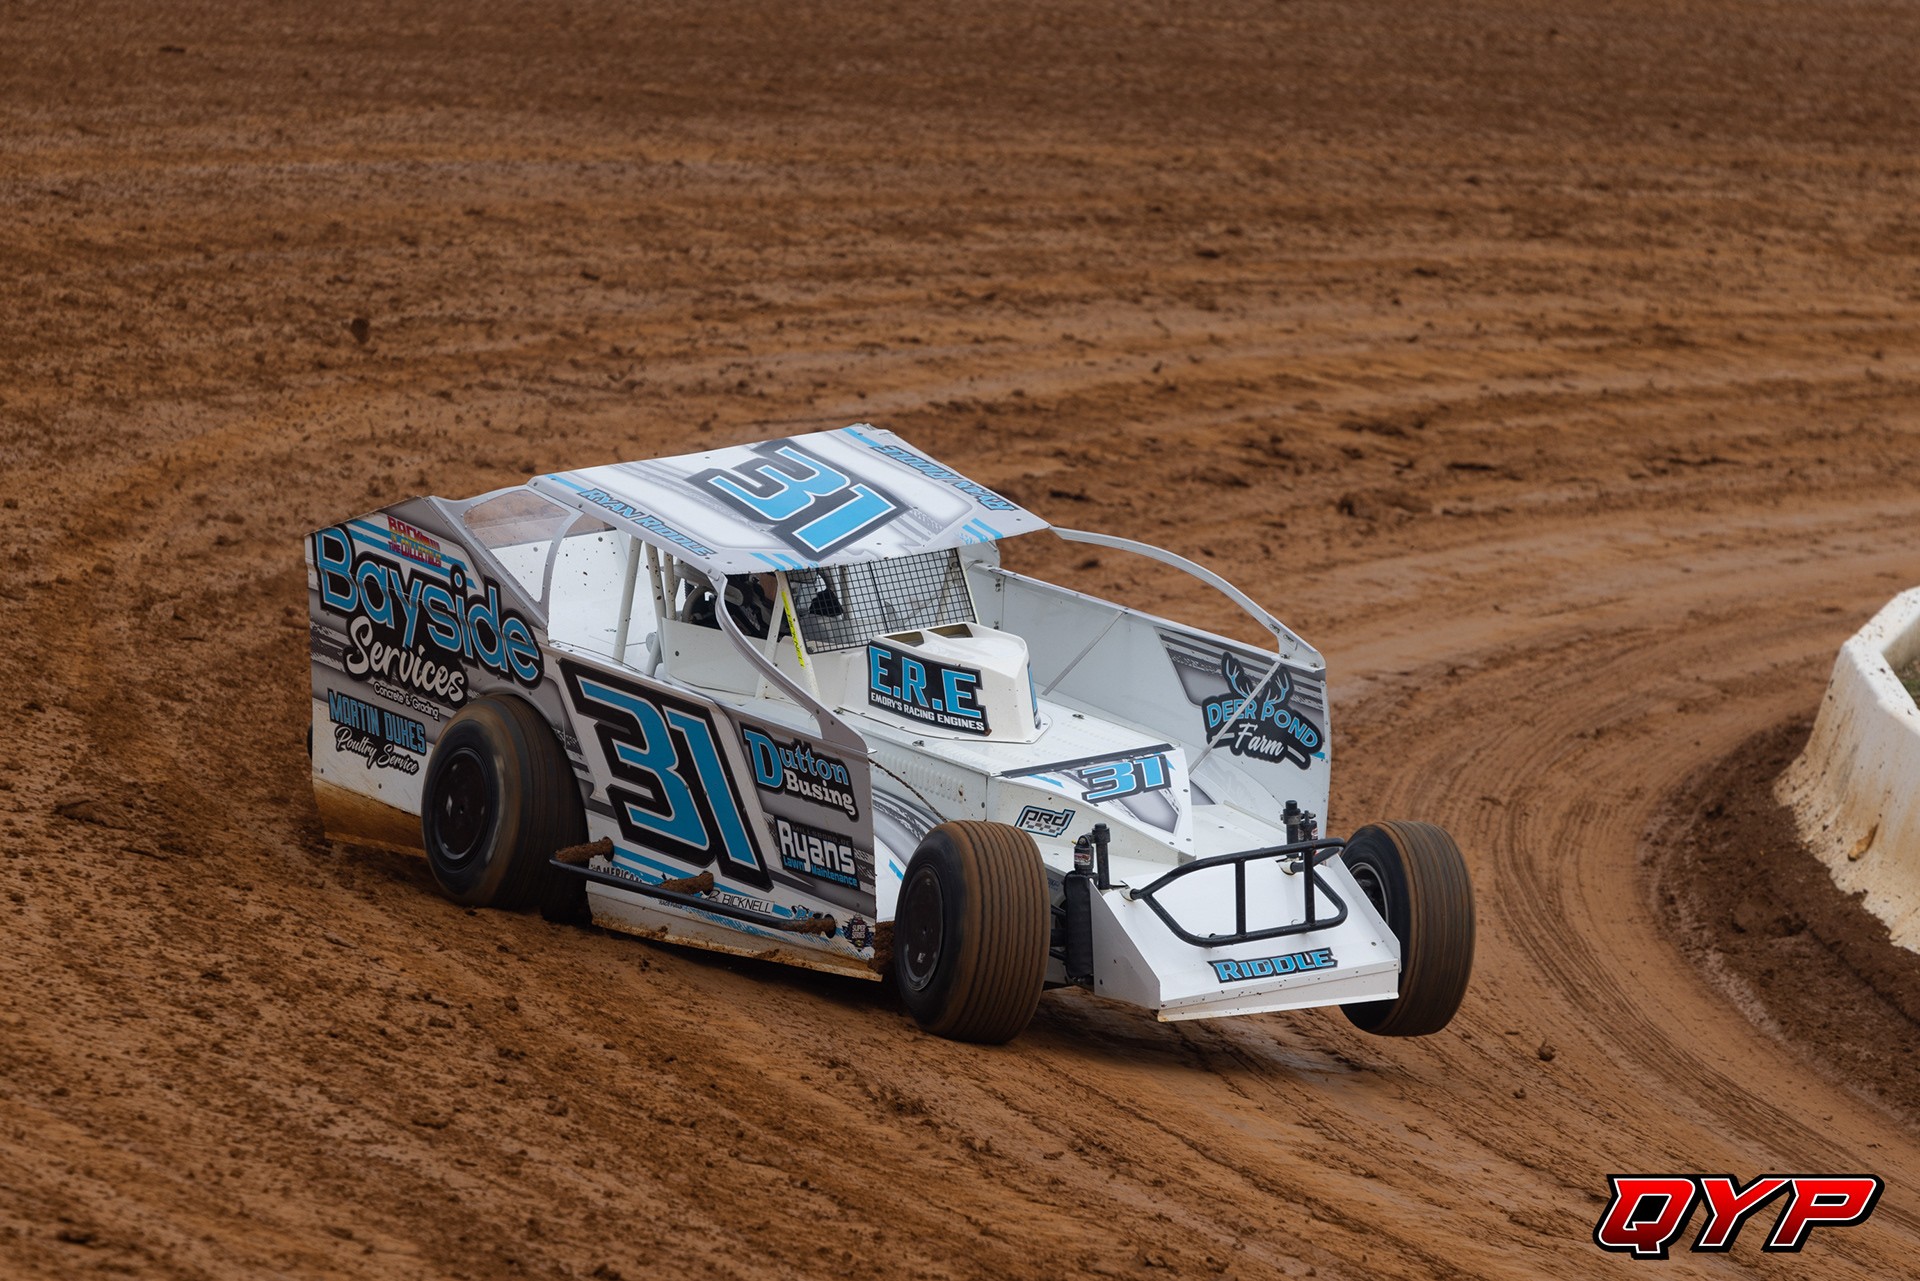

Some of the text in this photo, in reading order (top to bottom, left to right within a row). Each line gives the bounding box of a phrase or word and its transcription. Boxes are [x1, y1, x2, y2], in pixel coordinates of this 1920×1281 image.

[578, 488, 717, 556] RYAN RIDDLE
[706, 444, 897, 553] 31
[315, 526, 541, 682] Bayside
[346, 616, 465, 702] Services
[869, 646, 982, 718] E.R.E
[329, 691, 426, 754] MARTIN DUKES
[374, 683, 404, 704] Concrete
[412, 698, 439, 720] Grading
[871, 691, 985, 731] EMORY'S RACING ENGINES
[1206, 699, 1318, 748] DEER POND
[335, 726, 418, 773] Poultry Service
[743, 728, 849, 788] Dutton
[1234, 722, 1285, 757] Farm
[574, 673, 761, 873] 31
[783, 768, 856, 815] Busing
[1081, 756, 1165, 801] 31
[776, 819, 856, 875] Ryans
[783, 855, 858, 887] Lawn Maintenance
[722, 893, 771, 914] BICKNELL
[1212, 950, 1335, 981] RIDDLE
